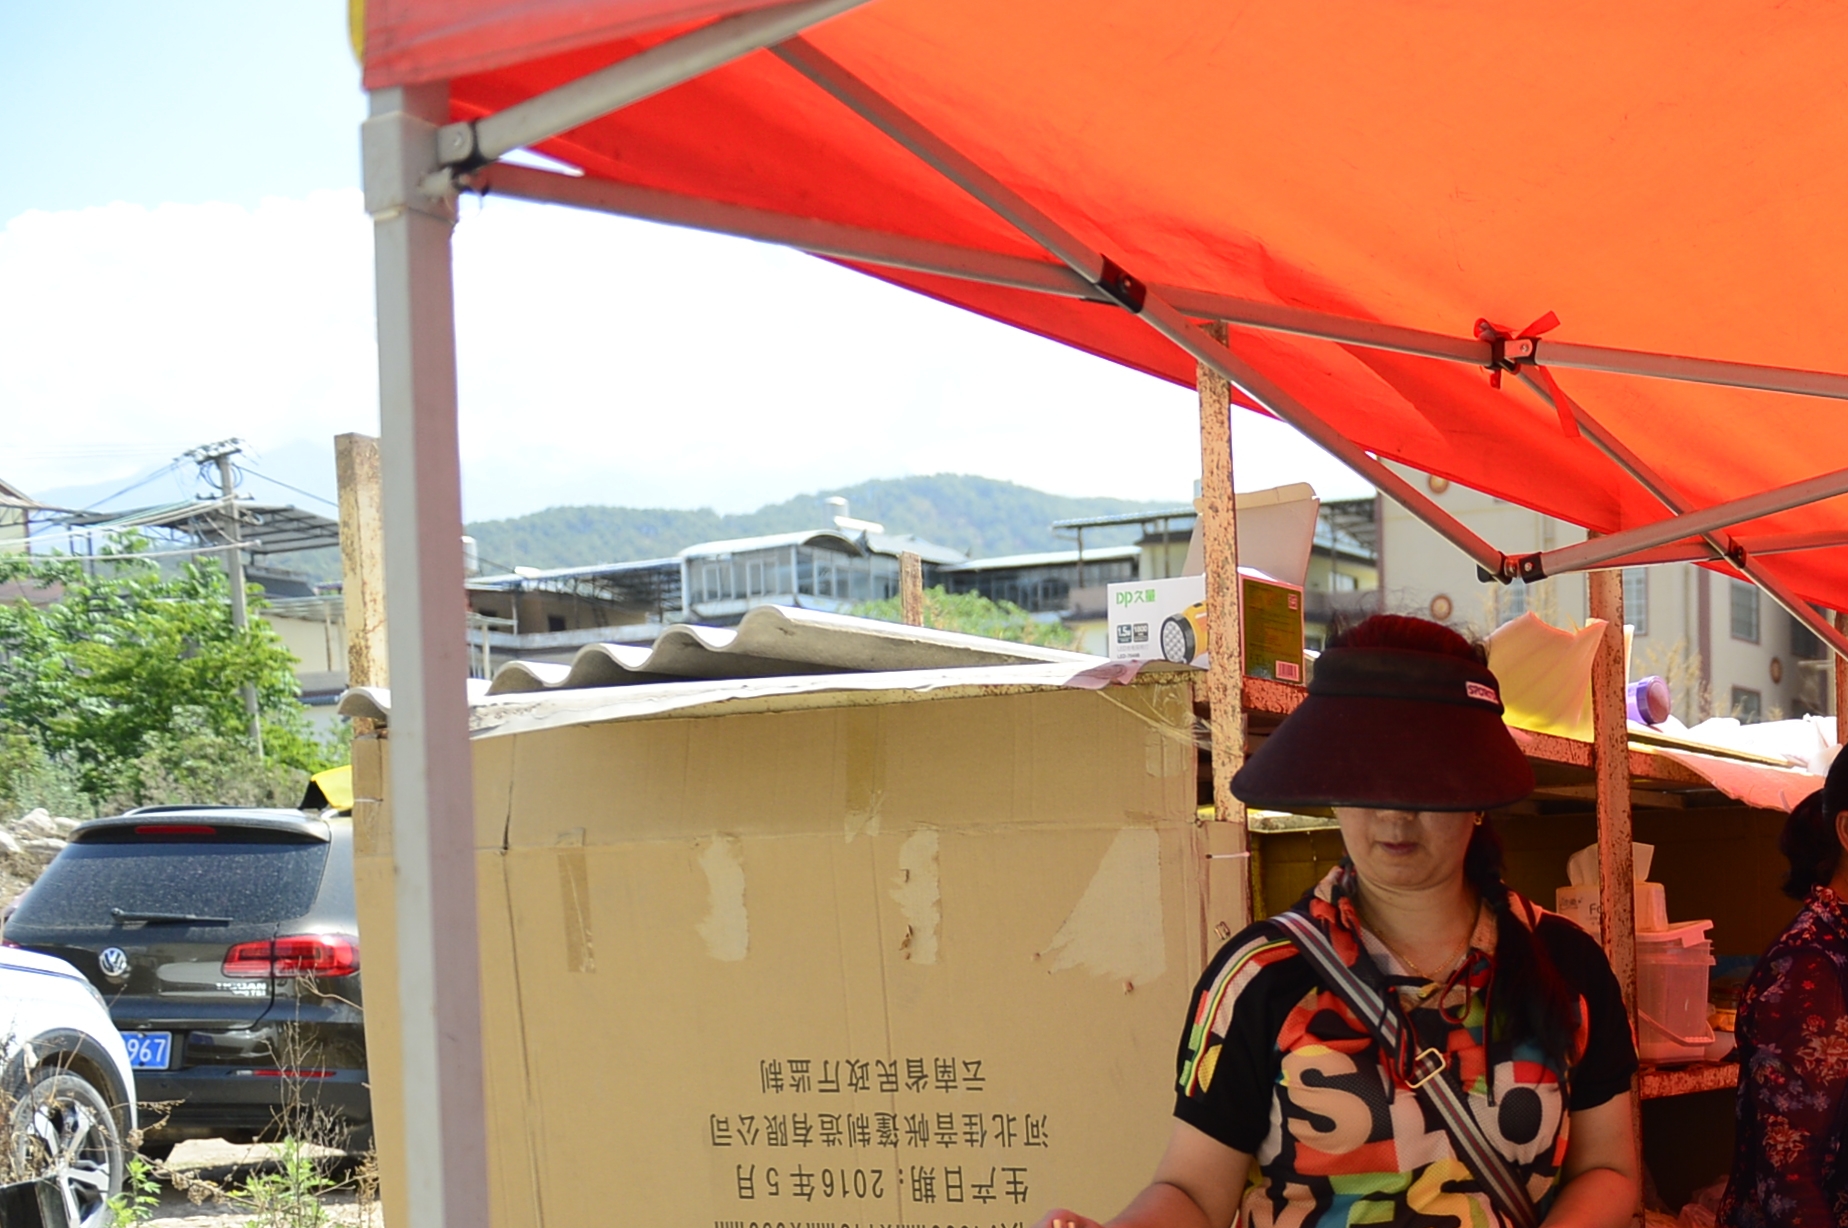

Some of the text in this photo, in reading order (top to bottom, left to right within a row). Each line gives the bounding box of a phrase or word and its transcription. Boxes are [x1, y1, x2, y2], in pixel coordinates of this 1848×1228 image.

[760, 1057, 986, 1093] 云南省民政厅监制
[709, 1112, 1049, 1148] 河北佳音帐篷制造有限公司
